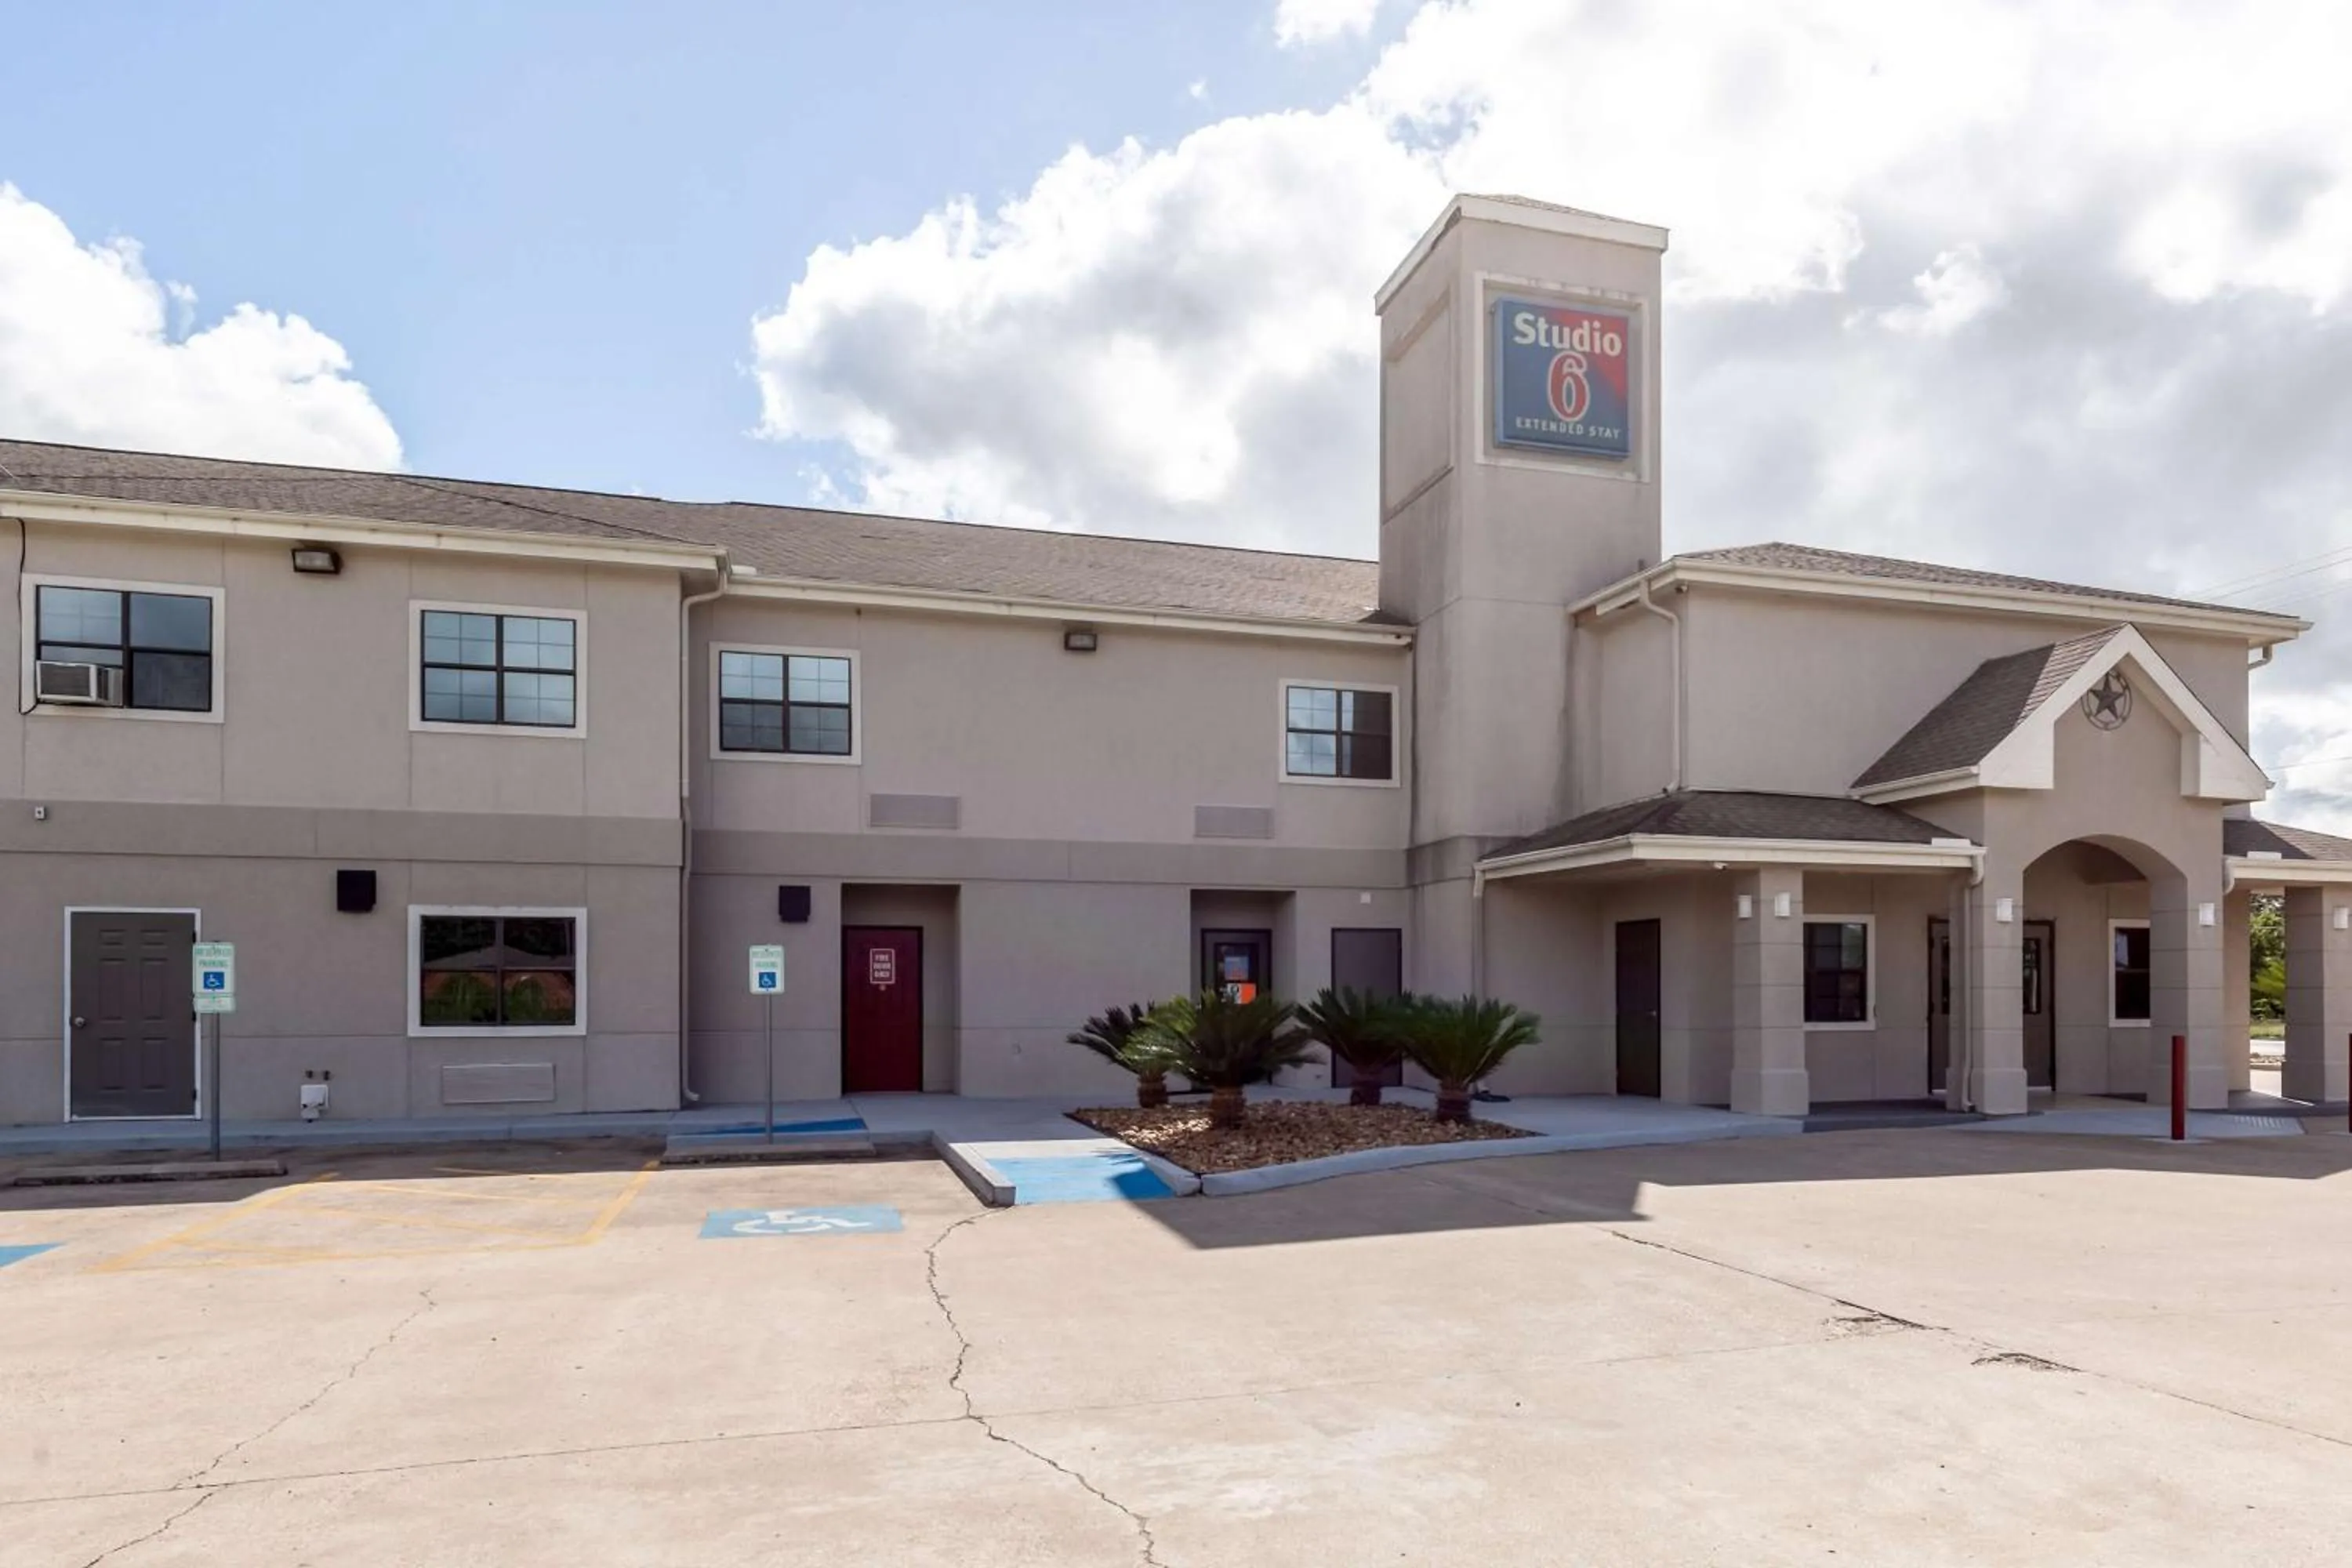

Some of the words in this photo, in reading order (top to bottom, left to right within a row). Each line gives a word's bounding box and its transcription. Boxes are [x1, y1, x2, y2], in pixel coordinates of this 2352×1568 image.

[1513, 312, 1622, 357] Studio
[1548, 350, 1591, 422] 6
[1515, 416, 1584, 435] EXTENDED
[1589, 424, 1621, 440] STAY
